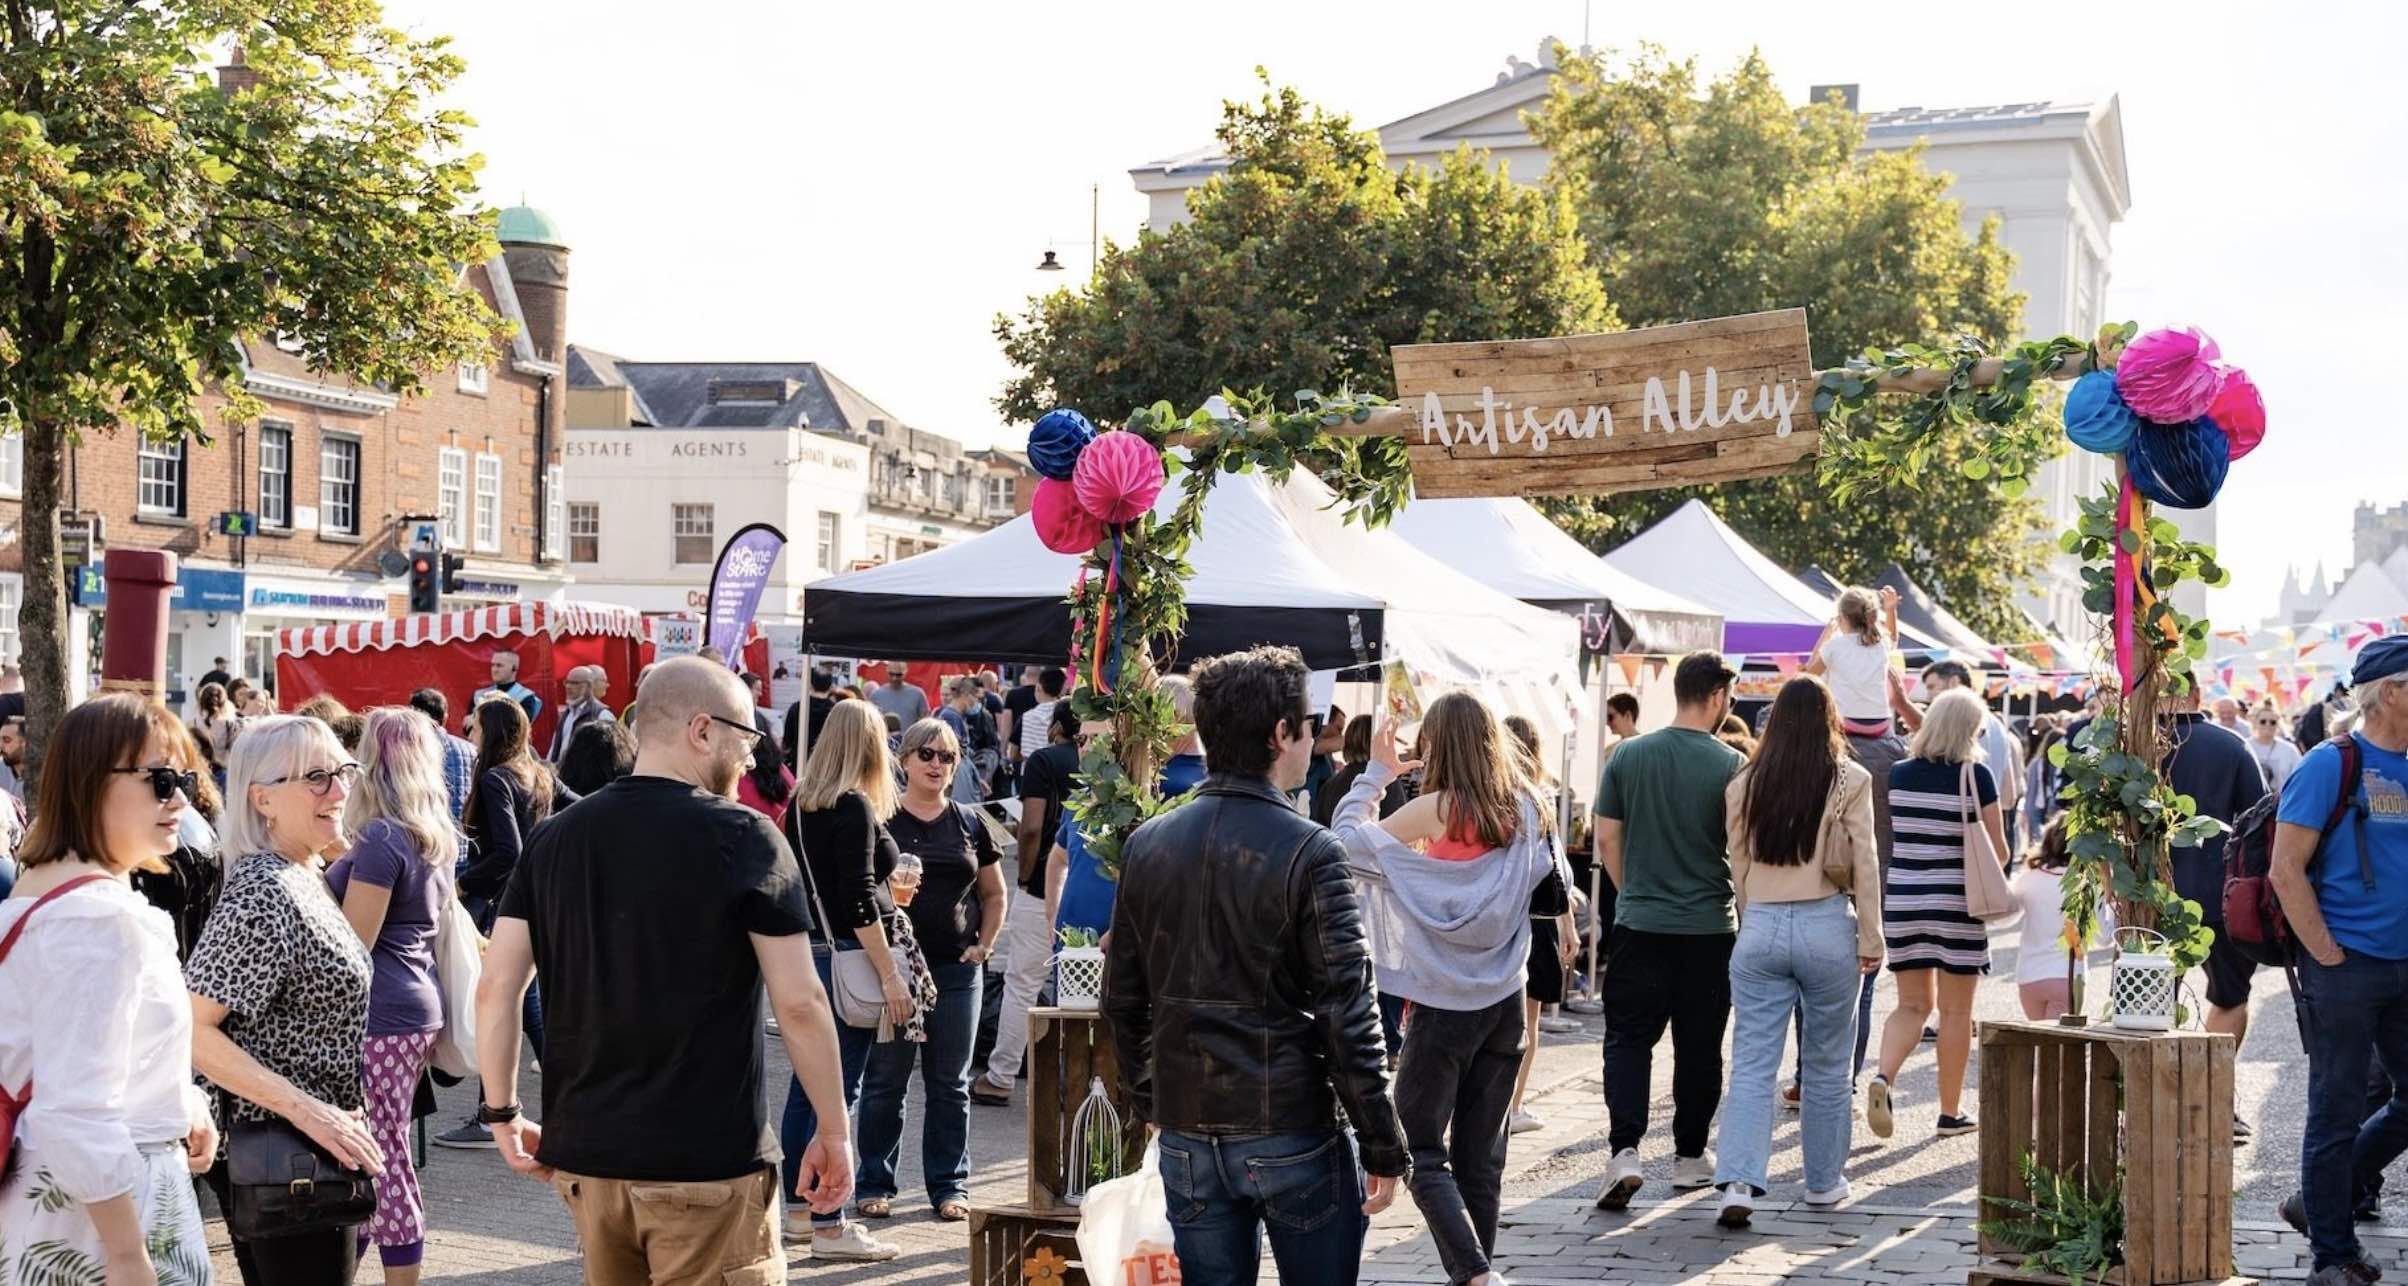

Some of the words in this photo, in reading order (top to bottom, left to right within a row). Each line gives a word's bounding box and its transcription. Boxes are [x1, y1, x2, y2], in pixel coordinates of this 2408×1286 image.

[1421, 385, 1614, 455] Artisan
[1642, 366, 1800, 438] Alley
[566, 442, 633, 457] ESTATE
[672, 442, 748, 457] AGENTS
